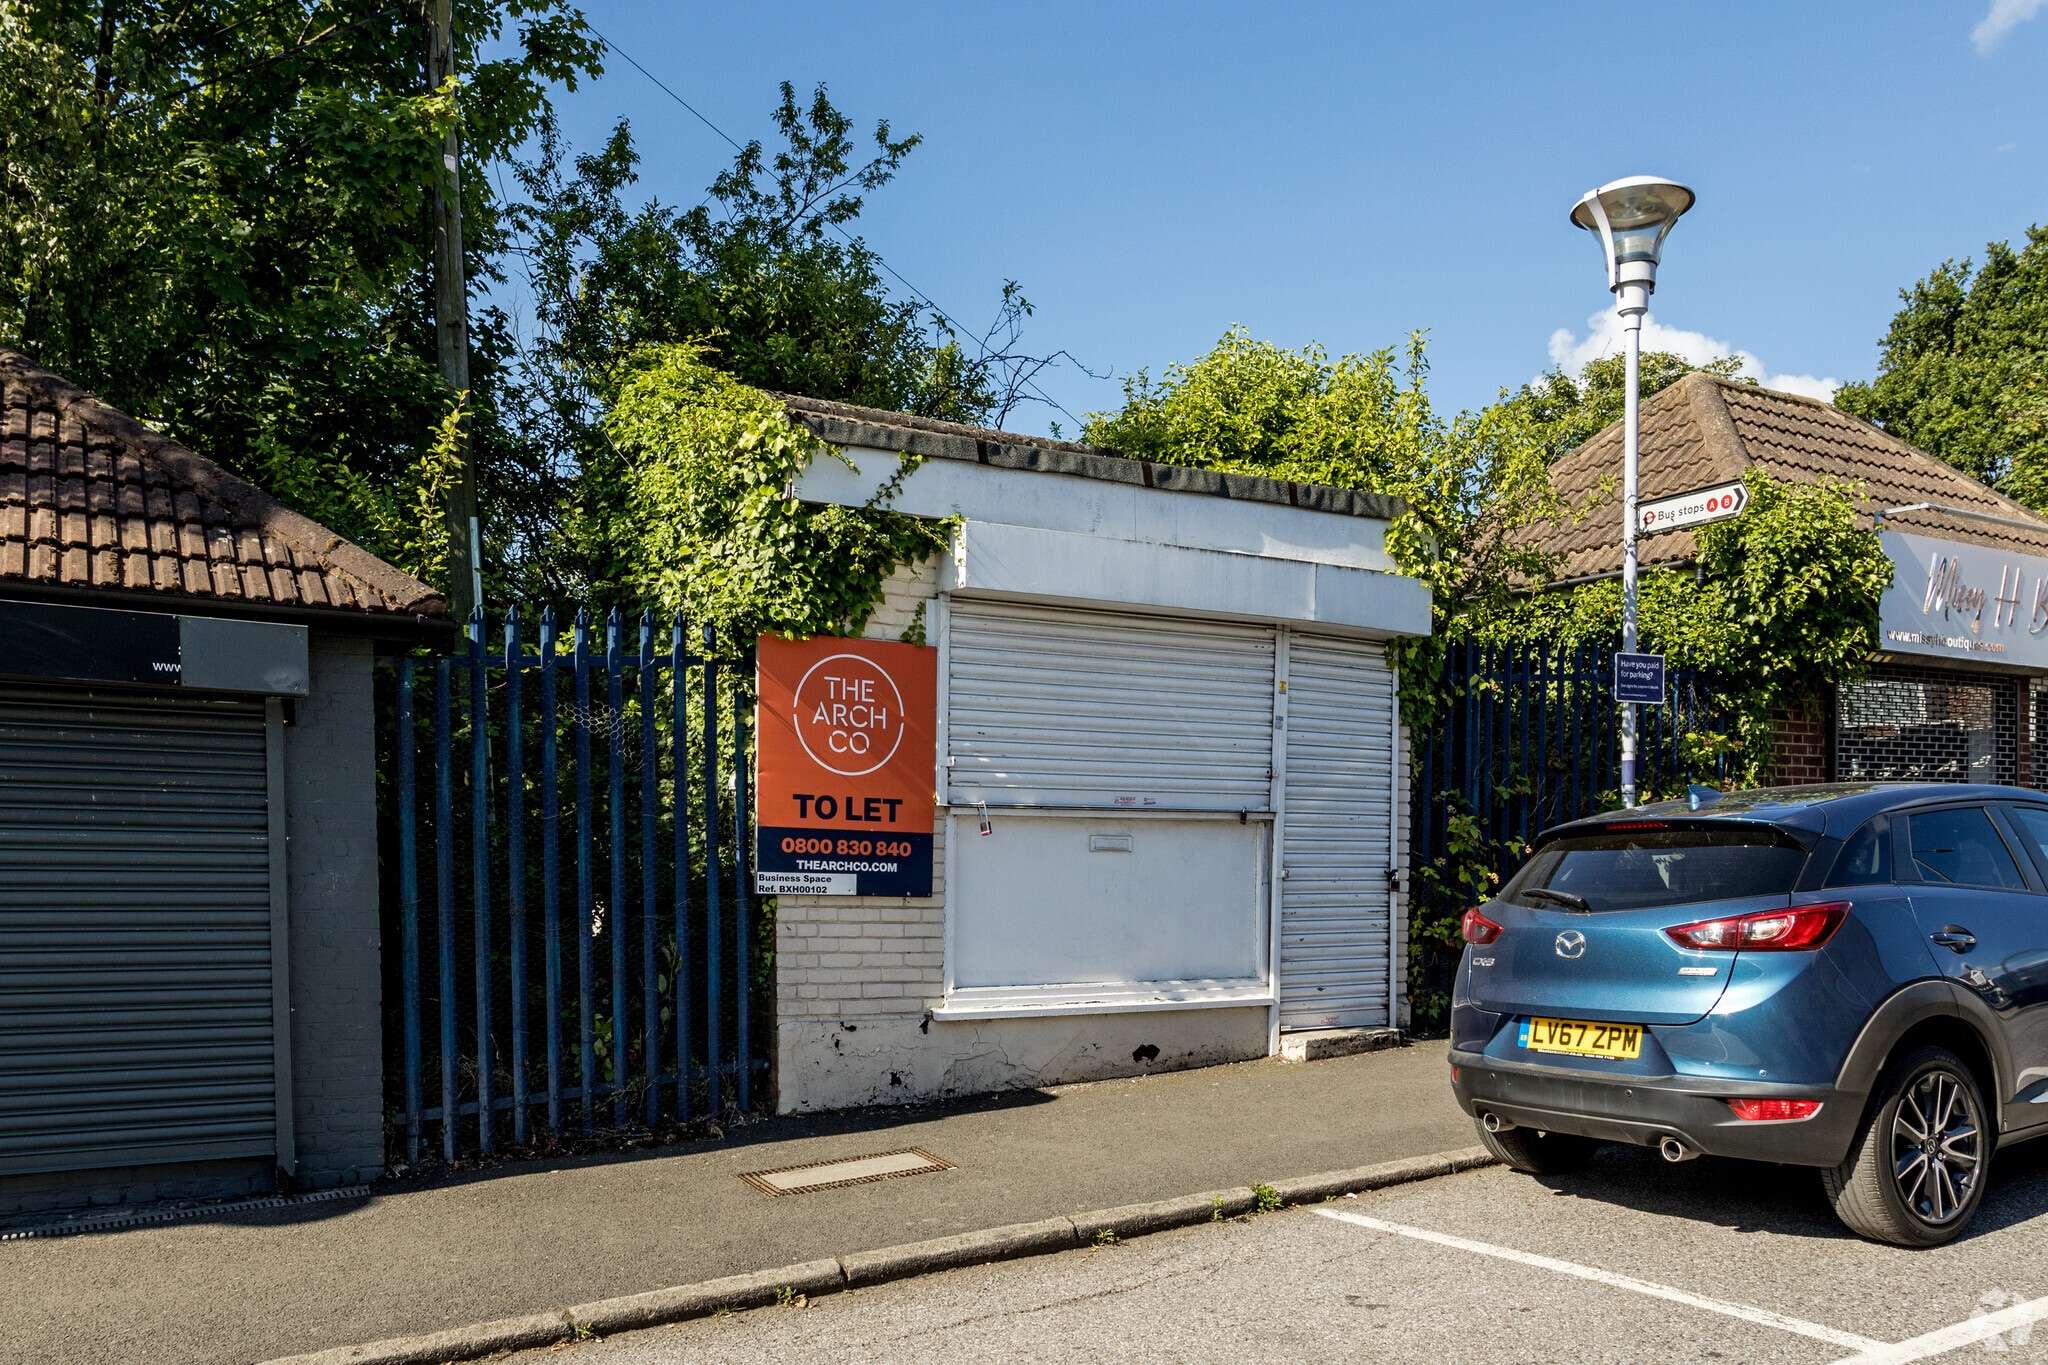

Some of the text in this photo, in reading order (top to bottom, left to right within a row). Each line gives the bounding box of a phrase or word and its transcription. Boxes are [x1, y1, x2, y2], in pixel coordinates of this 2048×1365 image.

[1658, 510, 1675, 520] Bus
[1678, 503, 1705, 516] stops
[1923, 552, 1985, 635] Missy
[1994, 565, 2020, 630] H
[1621, 660, 1659, 670] Have you paid
[1630, 671, 1653, 680] parking?
[823, 676, 875, 702] THE
[812, 701, 887, 730] ARCH
[829, 730, 870, 754] CO
[792, 793, 903, 822] TO LET
[781, 837, 911, 857] 0800 830 840
[796, 859, 897, 872] THEARCHCO.COM
[758, 874, 832, 884] Business Space
[758, 885, 827, 893] Ref. BXH00102
[1532, 1021, 1638, 1052] LV67 ZPM
